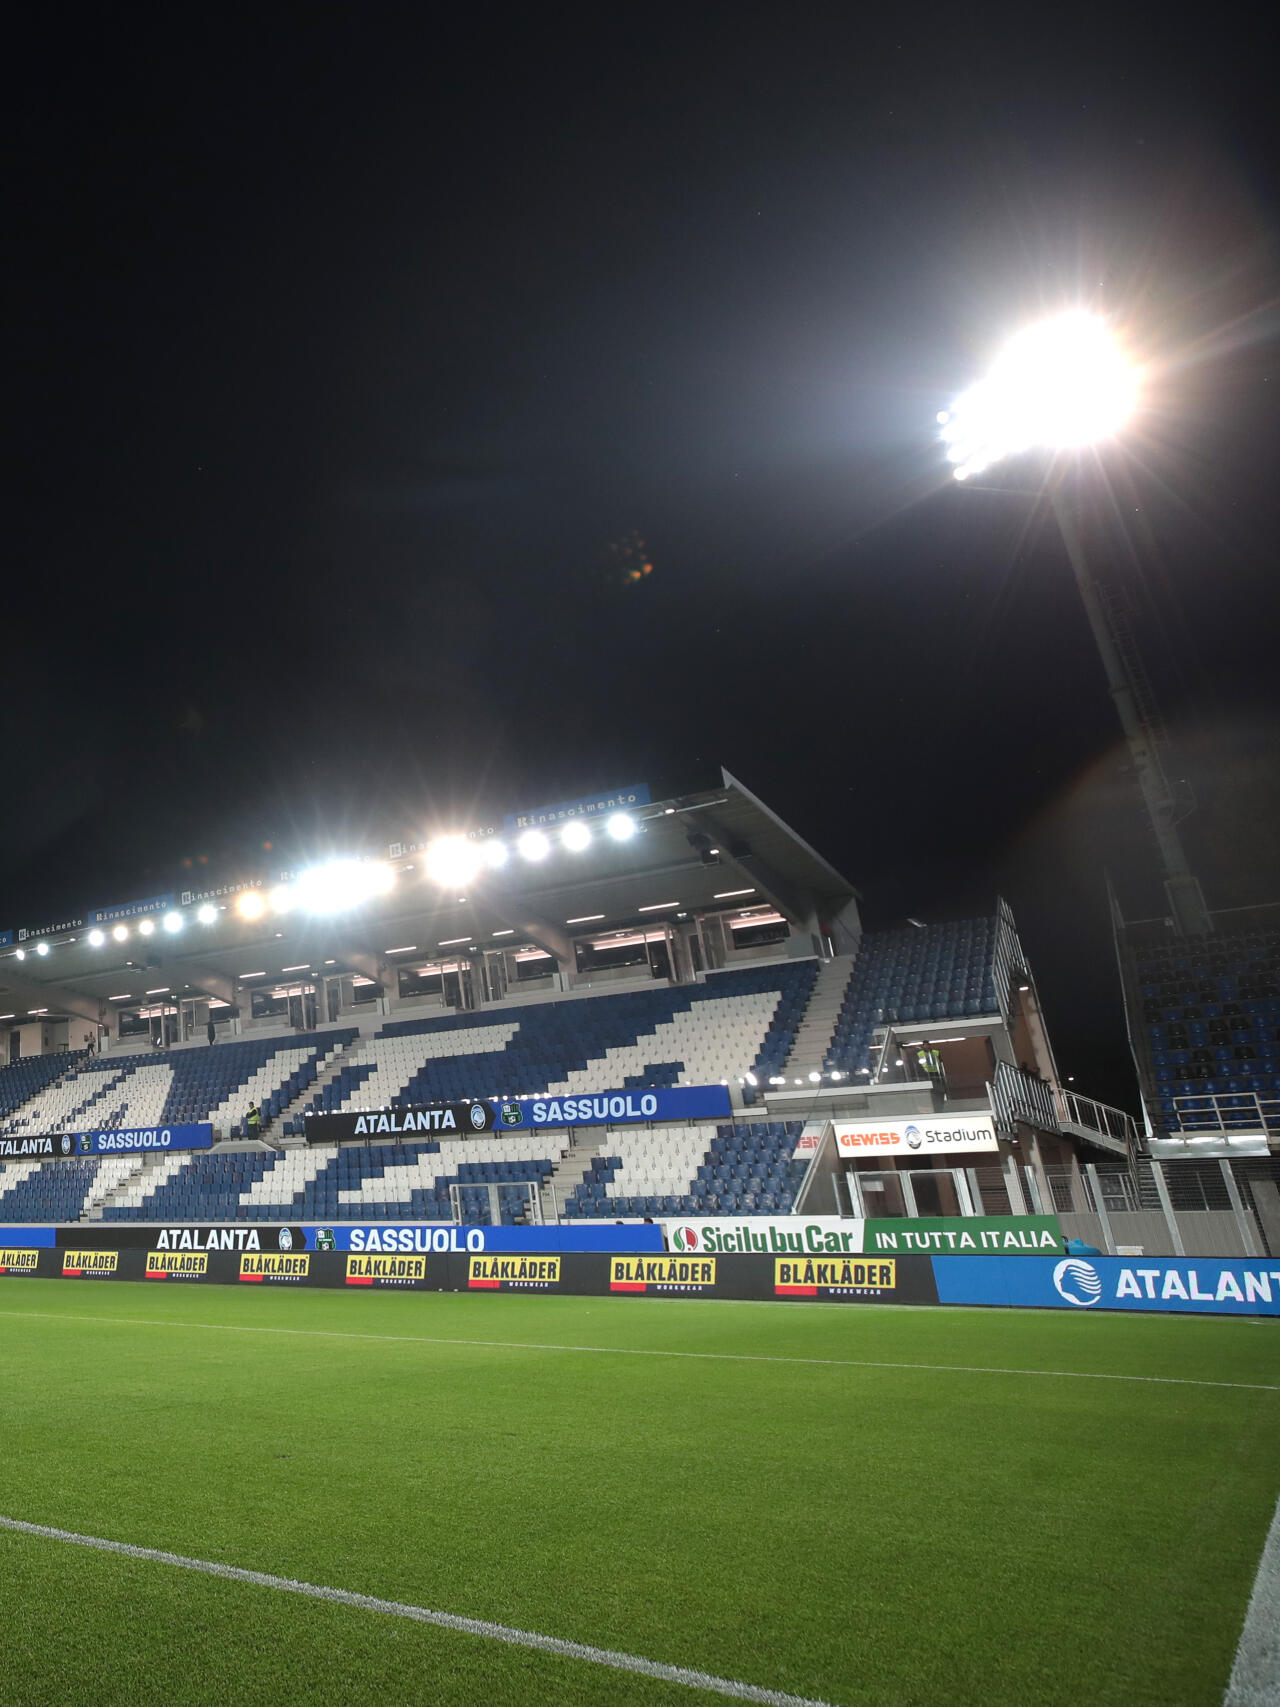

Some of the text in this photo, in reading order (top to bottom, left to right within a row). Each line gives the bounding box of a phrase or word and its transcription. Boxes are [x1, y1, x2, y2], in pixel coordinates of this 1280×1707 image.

[517, 793, 636, 828] Rinascimento
[389, 826, 495, 858] Rinanto
[181, 879, 263, 905] Rinascimento
[96, 901, 167, 922] Rinascimento
[19, 919, 82, 940] Rinascimento
[354, 1094, 657, 1135] ATALANTA SASSUOLO
[98, 1130, 171, 1150] SASSUOLO
[925, 1129, 993, 1144] Stadium
[156, 1228, 485, 1251] ATALANTA SASSUOLO
[805, 1225, 853, 1252] Car
[875, 1230, 1058, 1249] IN TUTTA ITALIA
[66, 1252, 116, 1270] BLÅKLÄDER
[148, 1253, 206, 1272] BLÅKLÄDER
[243, 1255, 307, 1275] BLÅKLÄDER
[349, 1256, 423, 1278] BLÅKLÄDER
[473, 1257, 556, 1280] BLÅKLÄDER
[614, 1258, 712, 1283] BLÅKLÄDER
[780, 1259, 891, 1286] BLÅKLÄDER
[828, 1287, 881, 1295] WORKWEAR
